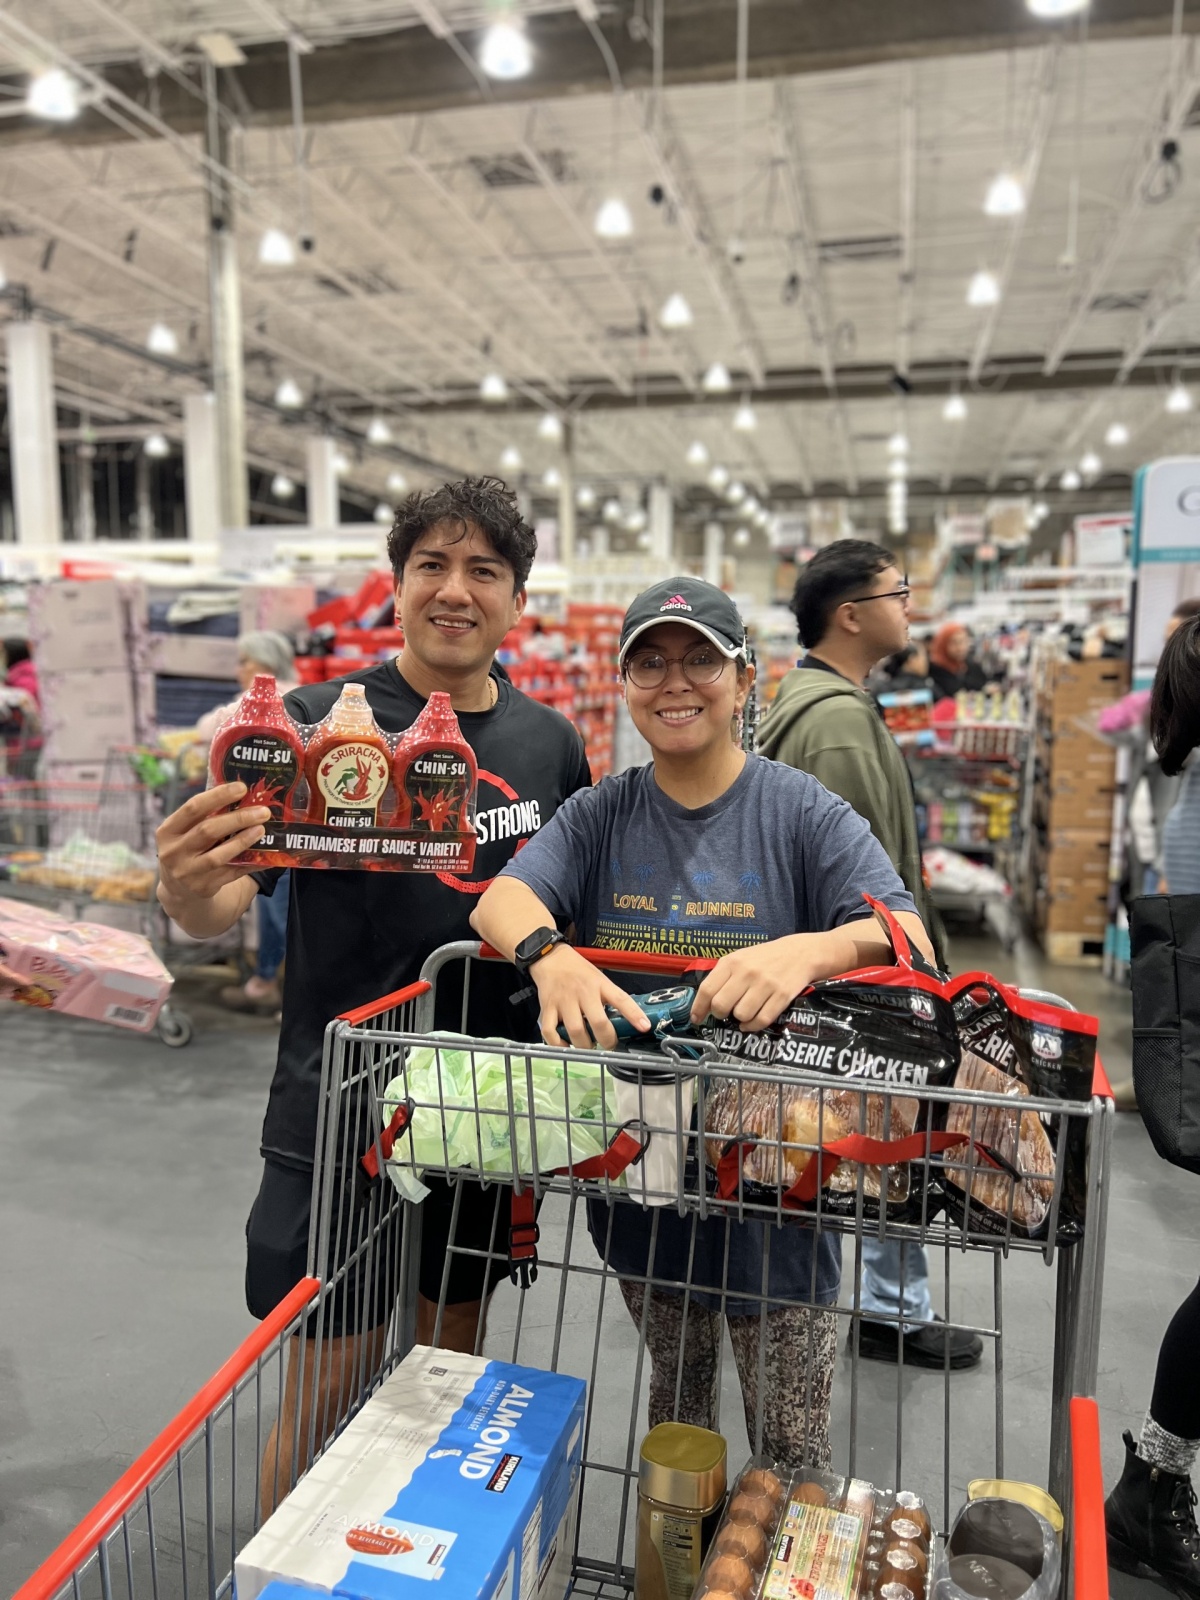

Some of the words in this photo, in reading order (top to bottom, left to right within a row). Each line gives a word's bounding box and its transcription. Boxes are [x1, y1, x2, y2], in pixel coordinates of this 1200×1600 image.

[660, 602, 692, 612] adidas
[233, 745, 291, 764] CHIN-SU
[330, 746, 381, 764] SRIRACHA
[414, 760, 466, 776] CHIN-SU
[328, 816, 372, 827] CHIN-SU
[475, 799, 541, 845] STRONG
[286, 834, 357, 853] VIETNAMESE
[358, 840, 380, 853] HOT
[382, 839, 417, 855] SAUCE
[420, 842, 462, 857] VARIETY
[613, 892, 658, 912] LOYAL
[685, 902, 755, 918] RUNNER
[605, 936, 627, 951] SAN
[629, 941, 699, 957] FRANCISCO
[837, 1049, 929, 1085] CHICKEN
[468, 1406, 491, 1431] BEVERAGE
[459, 1383, 535, 1480] ALMOND
[494, 1455, 517, 1492] KIRKLAND
[333, 1514, 435, 1547] ALMOND
[358, 1536, 386, 1547] BEVERAGE
